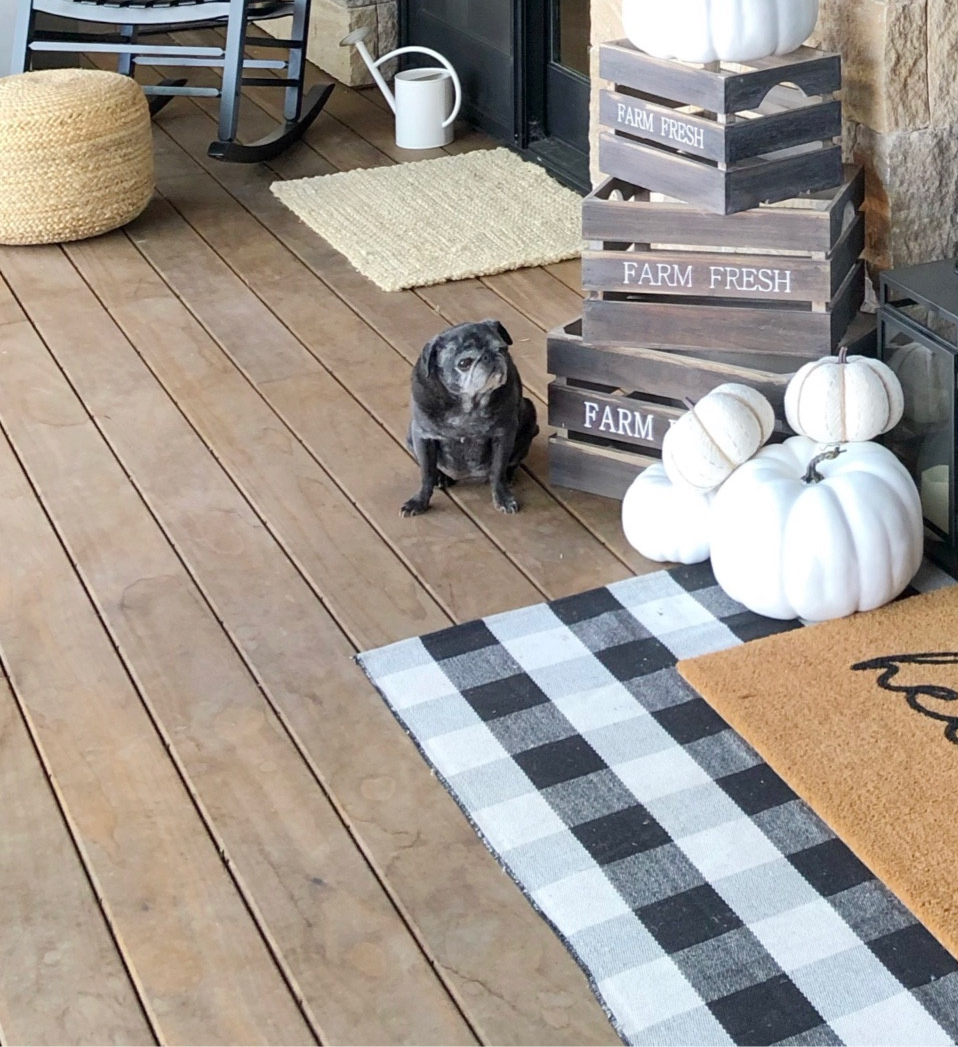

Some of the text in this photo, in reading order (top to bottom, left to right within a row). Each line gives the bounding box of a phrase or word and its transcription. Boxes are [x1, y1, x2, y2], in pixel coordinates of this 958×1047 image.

[617, 103, 705, 150] FARM FRESH
[622, 261, 792, 294] FARM FRESH
[584, 401, 655, 441] FARM
